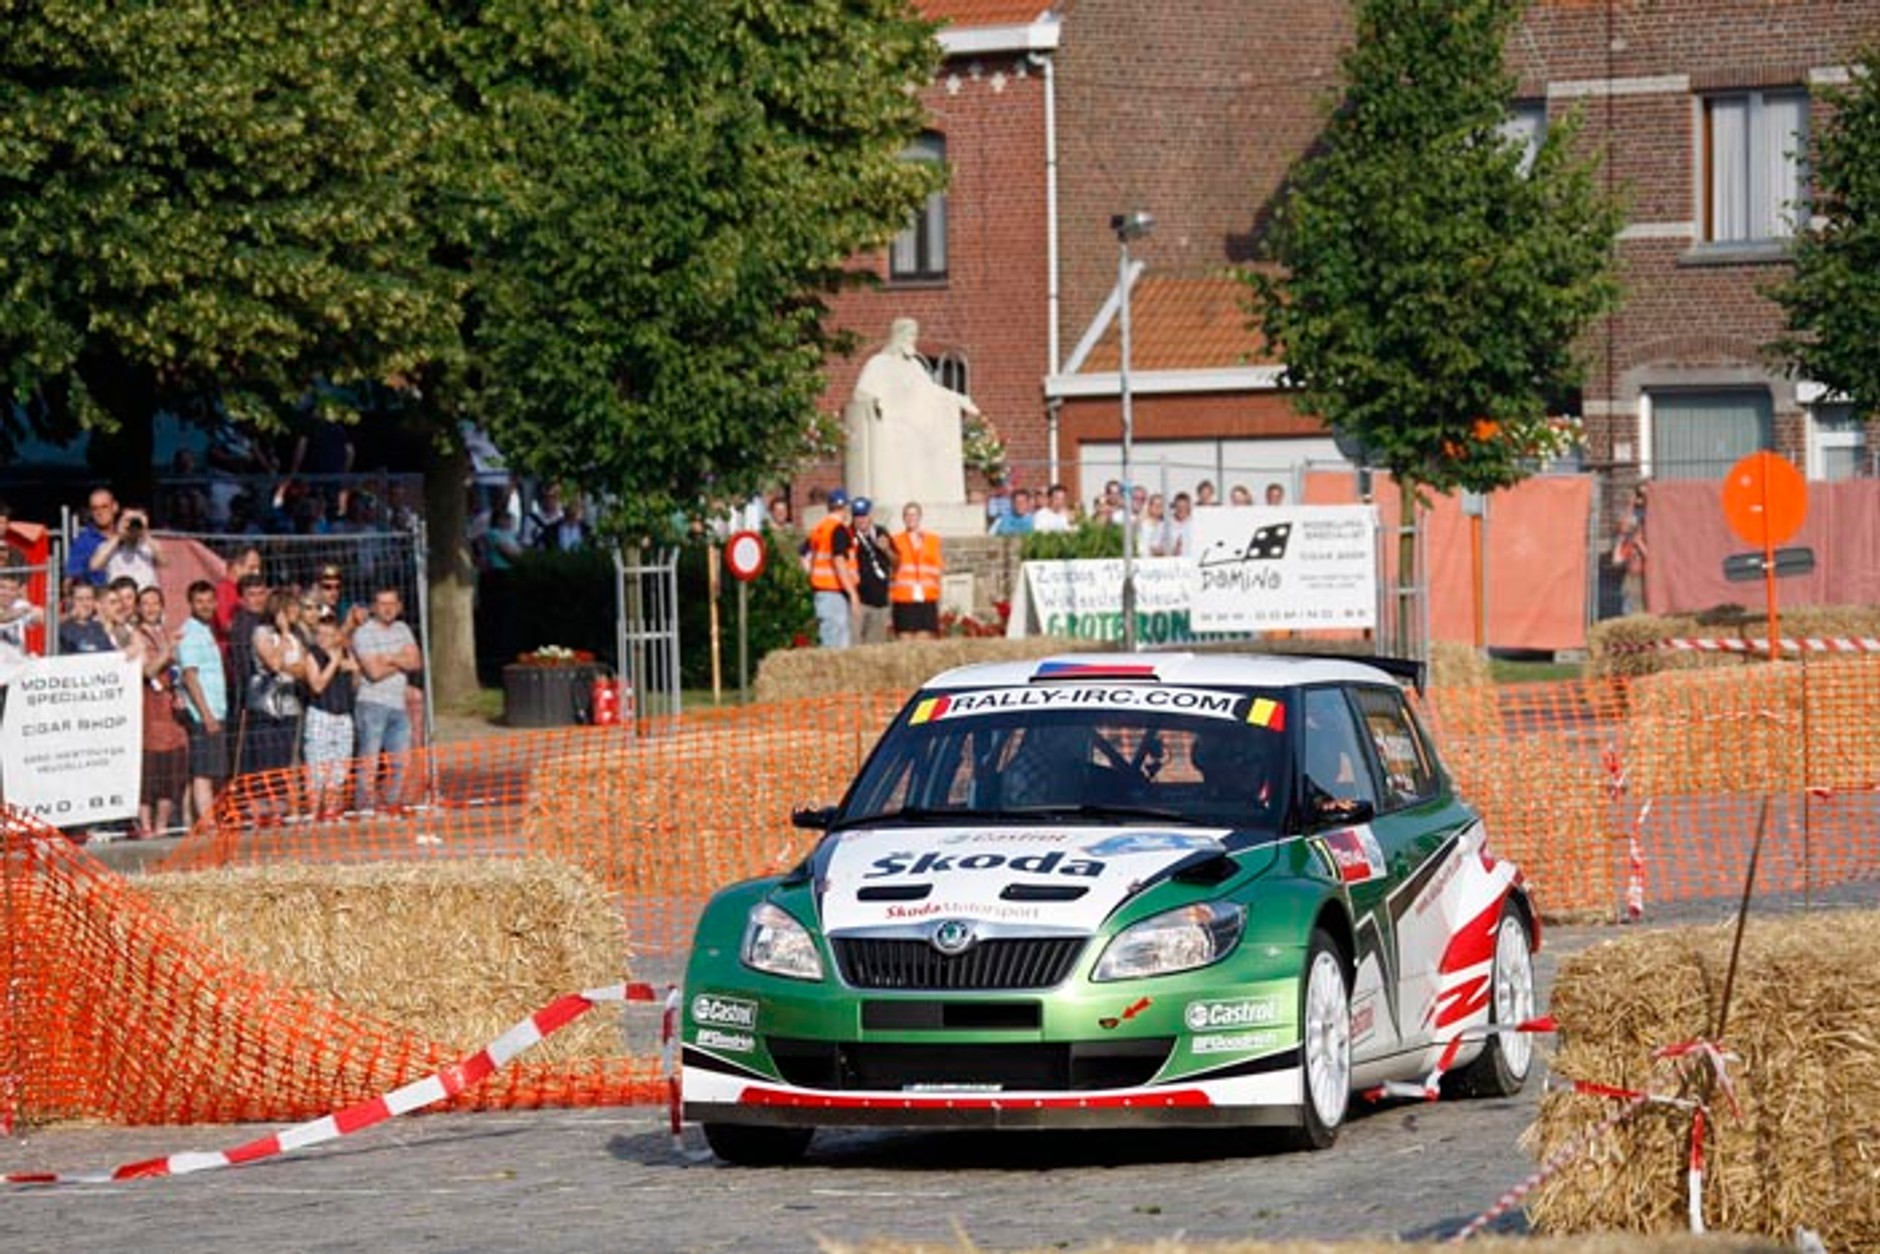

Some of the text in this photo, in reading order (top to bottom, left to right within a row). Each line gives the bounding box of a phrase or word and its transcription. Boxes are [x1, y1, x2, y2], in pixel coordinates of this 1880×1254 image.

[21, 672, 120, 691] MODELLING
[27, 687, 124, 707] SPECIALIST
[951, 689, 1233, 713] RALLY-IRC.COM
[21, 716, 127, 737] CIGAR SHOP
[709, 1002, 752, 1024] Castrol
[1210, 1001, 1276, 1024] Castrol
